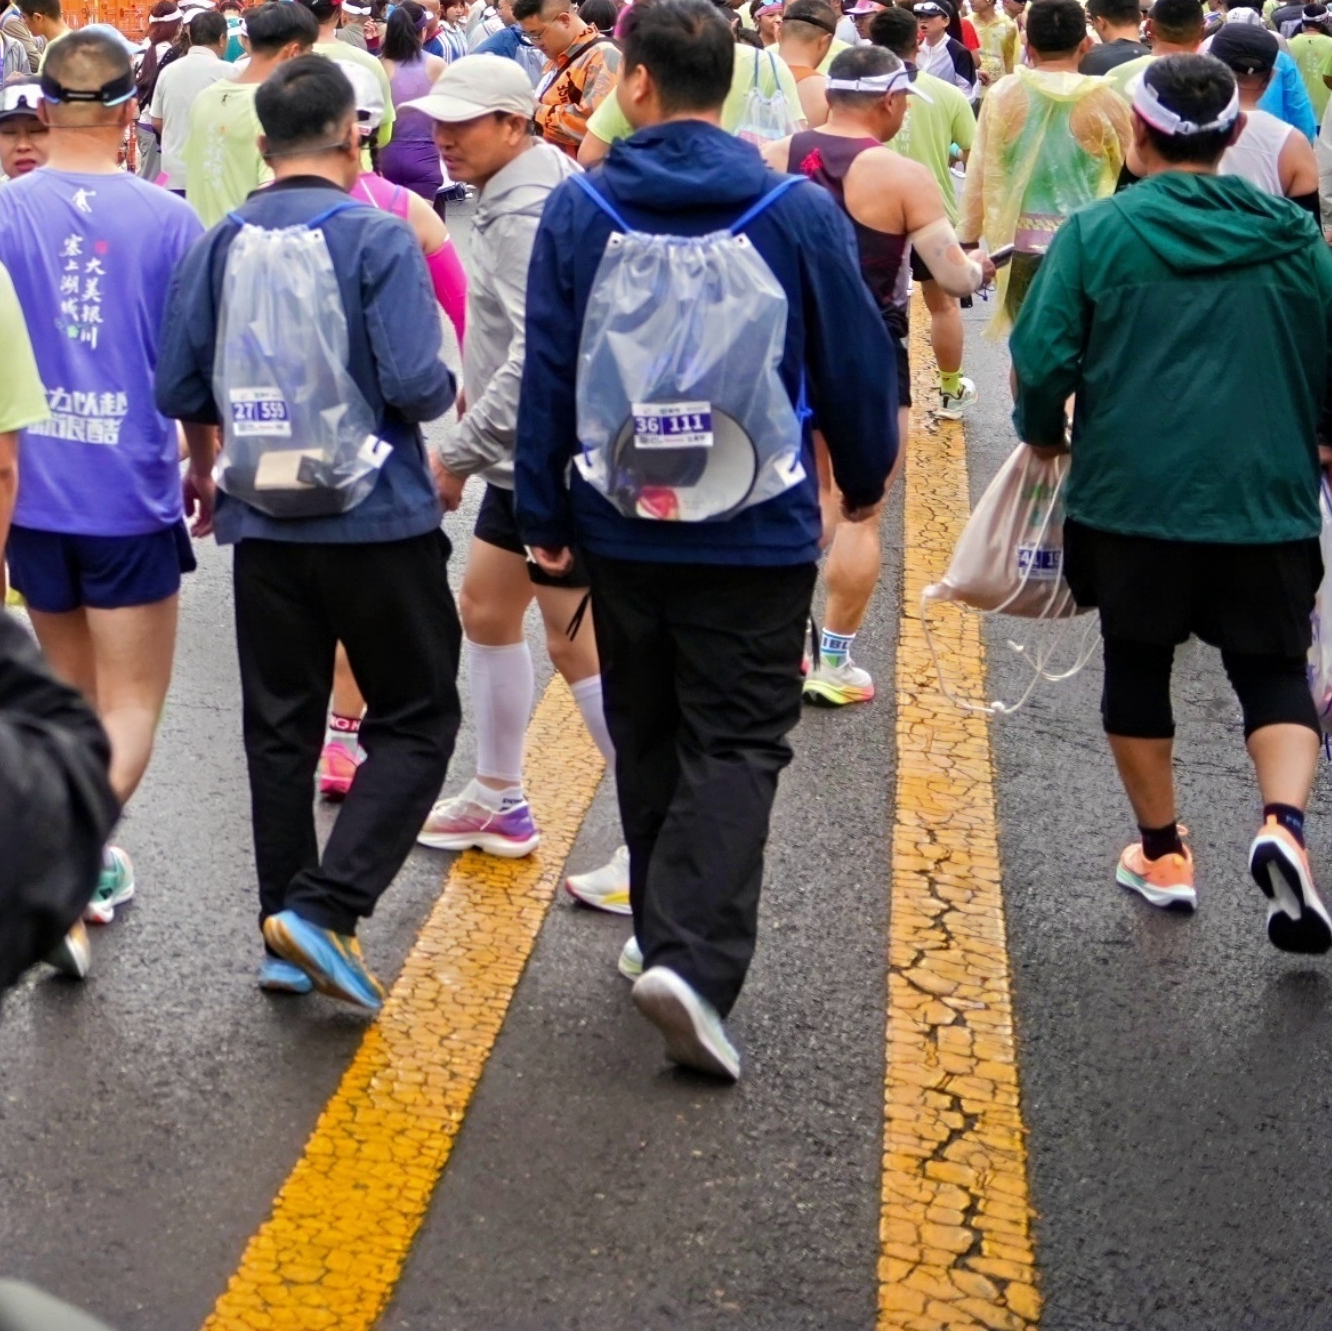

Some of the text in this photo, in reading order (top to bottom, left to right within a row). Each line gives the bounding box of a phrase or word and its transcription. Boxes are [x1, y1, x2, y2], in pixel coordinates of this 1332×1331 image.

[45, 386, 129, 417] 力以赴
[635, 414, 705, 433] 36 111
